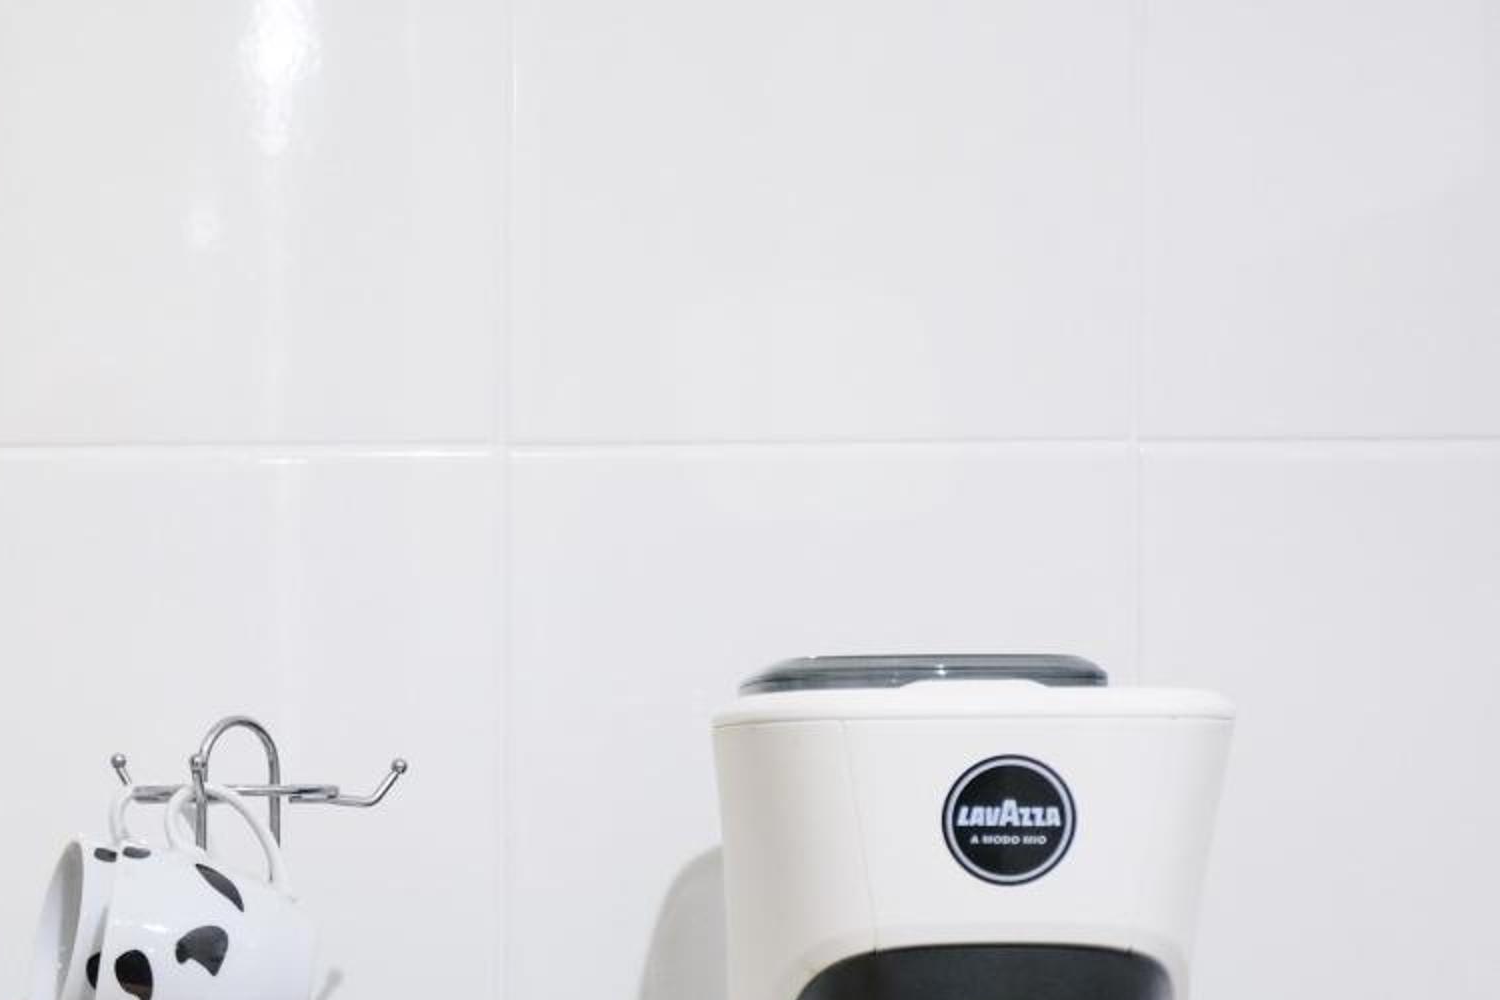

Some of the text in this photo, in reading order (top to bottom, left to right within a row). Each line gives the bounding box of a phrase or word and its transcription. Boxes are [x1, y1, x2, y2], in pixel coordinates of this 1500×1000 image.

[956, 798, 1062, 827] LAVAZZA
[970, 834, 1047, 845] A MODO MIO
